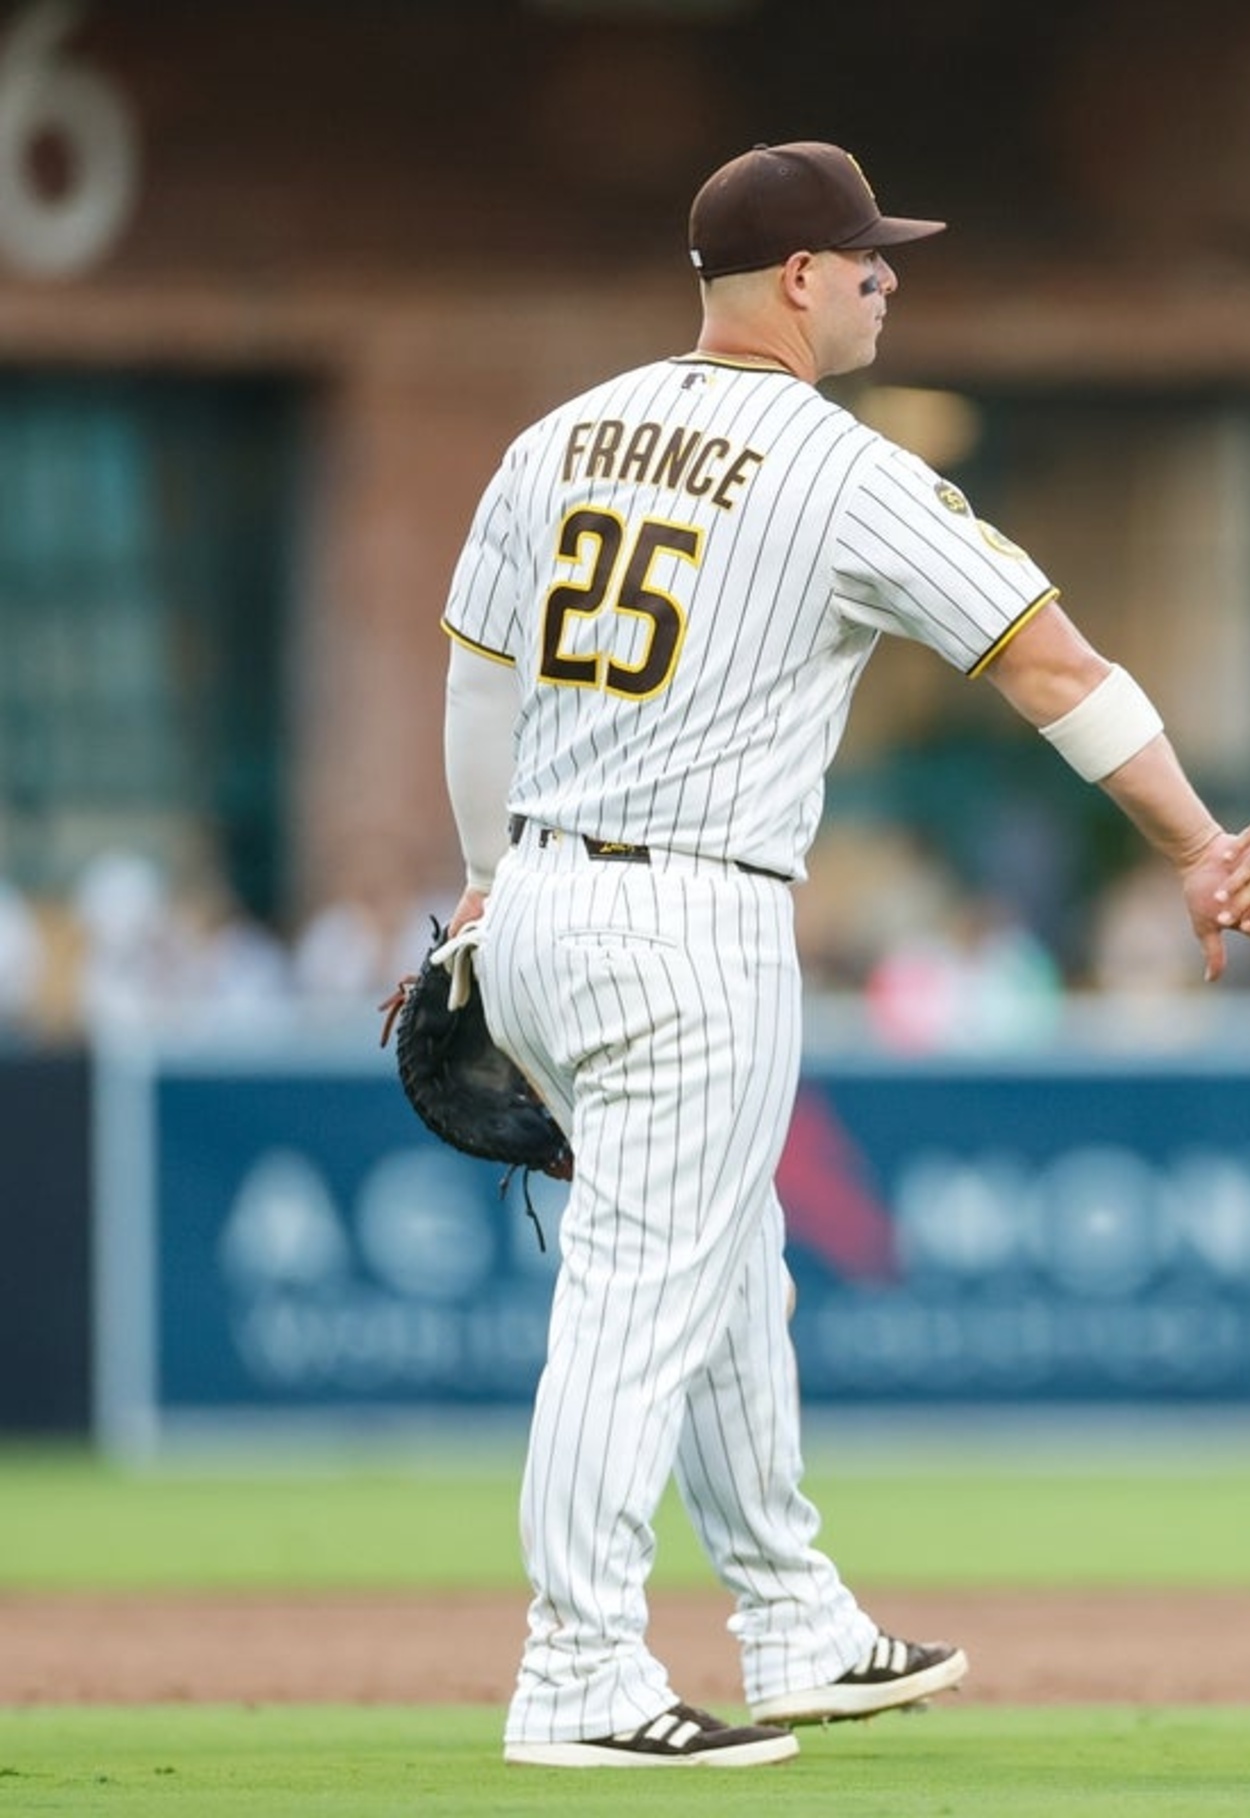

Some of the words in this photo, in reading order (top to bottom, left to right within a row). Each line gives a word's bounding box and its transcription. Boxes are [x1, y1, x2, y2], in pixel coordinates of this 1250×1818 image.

[0, 0, 140, 272] 6
[561, 418, 765, 511] FRANCE
[538, 504, 704, 702] 25
